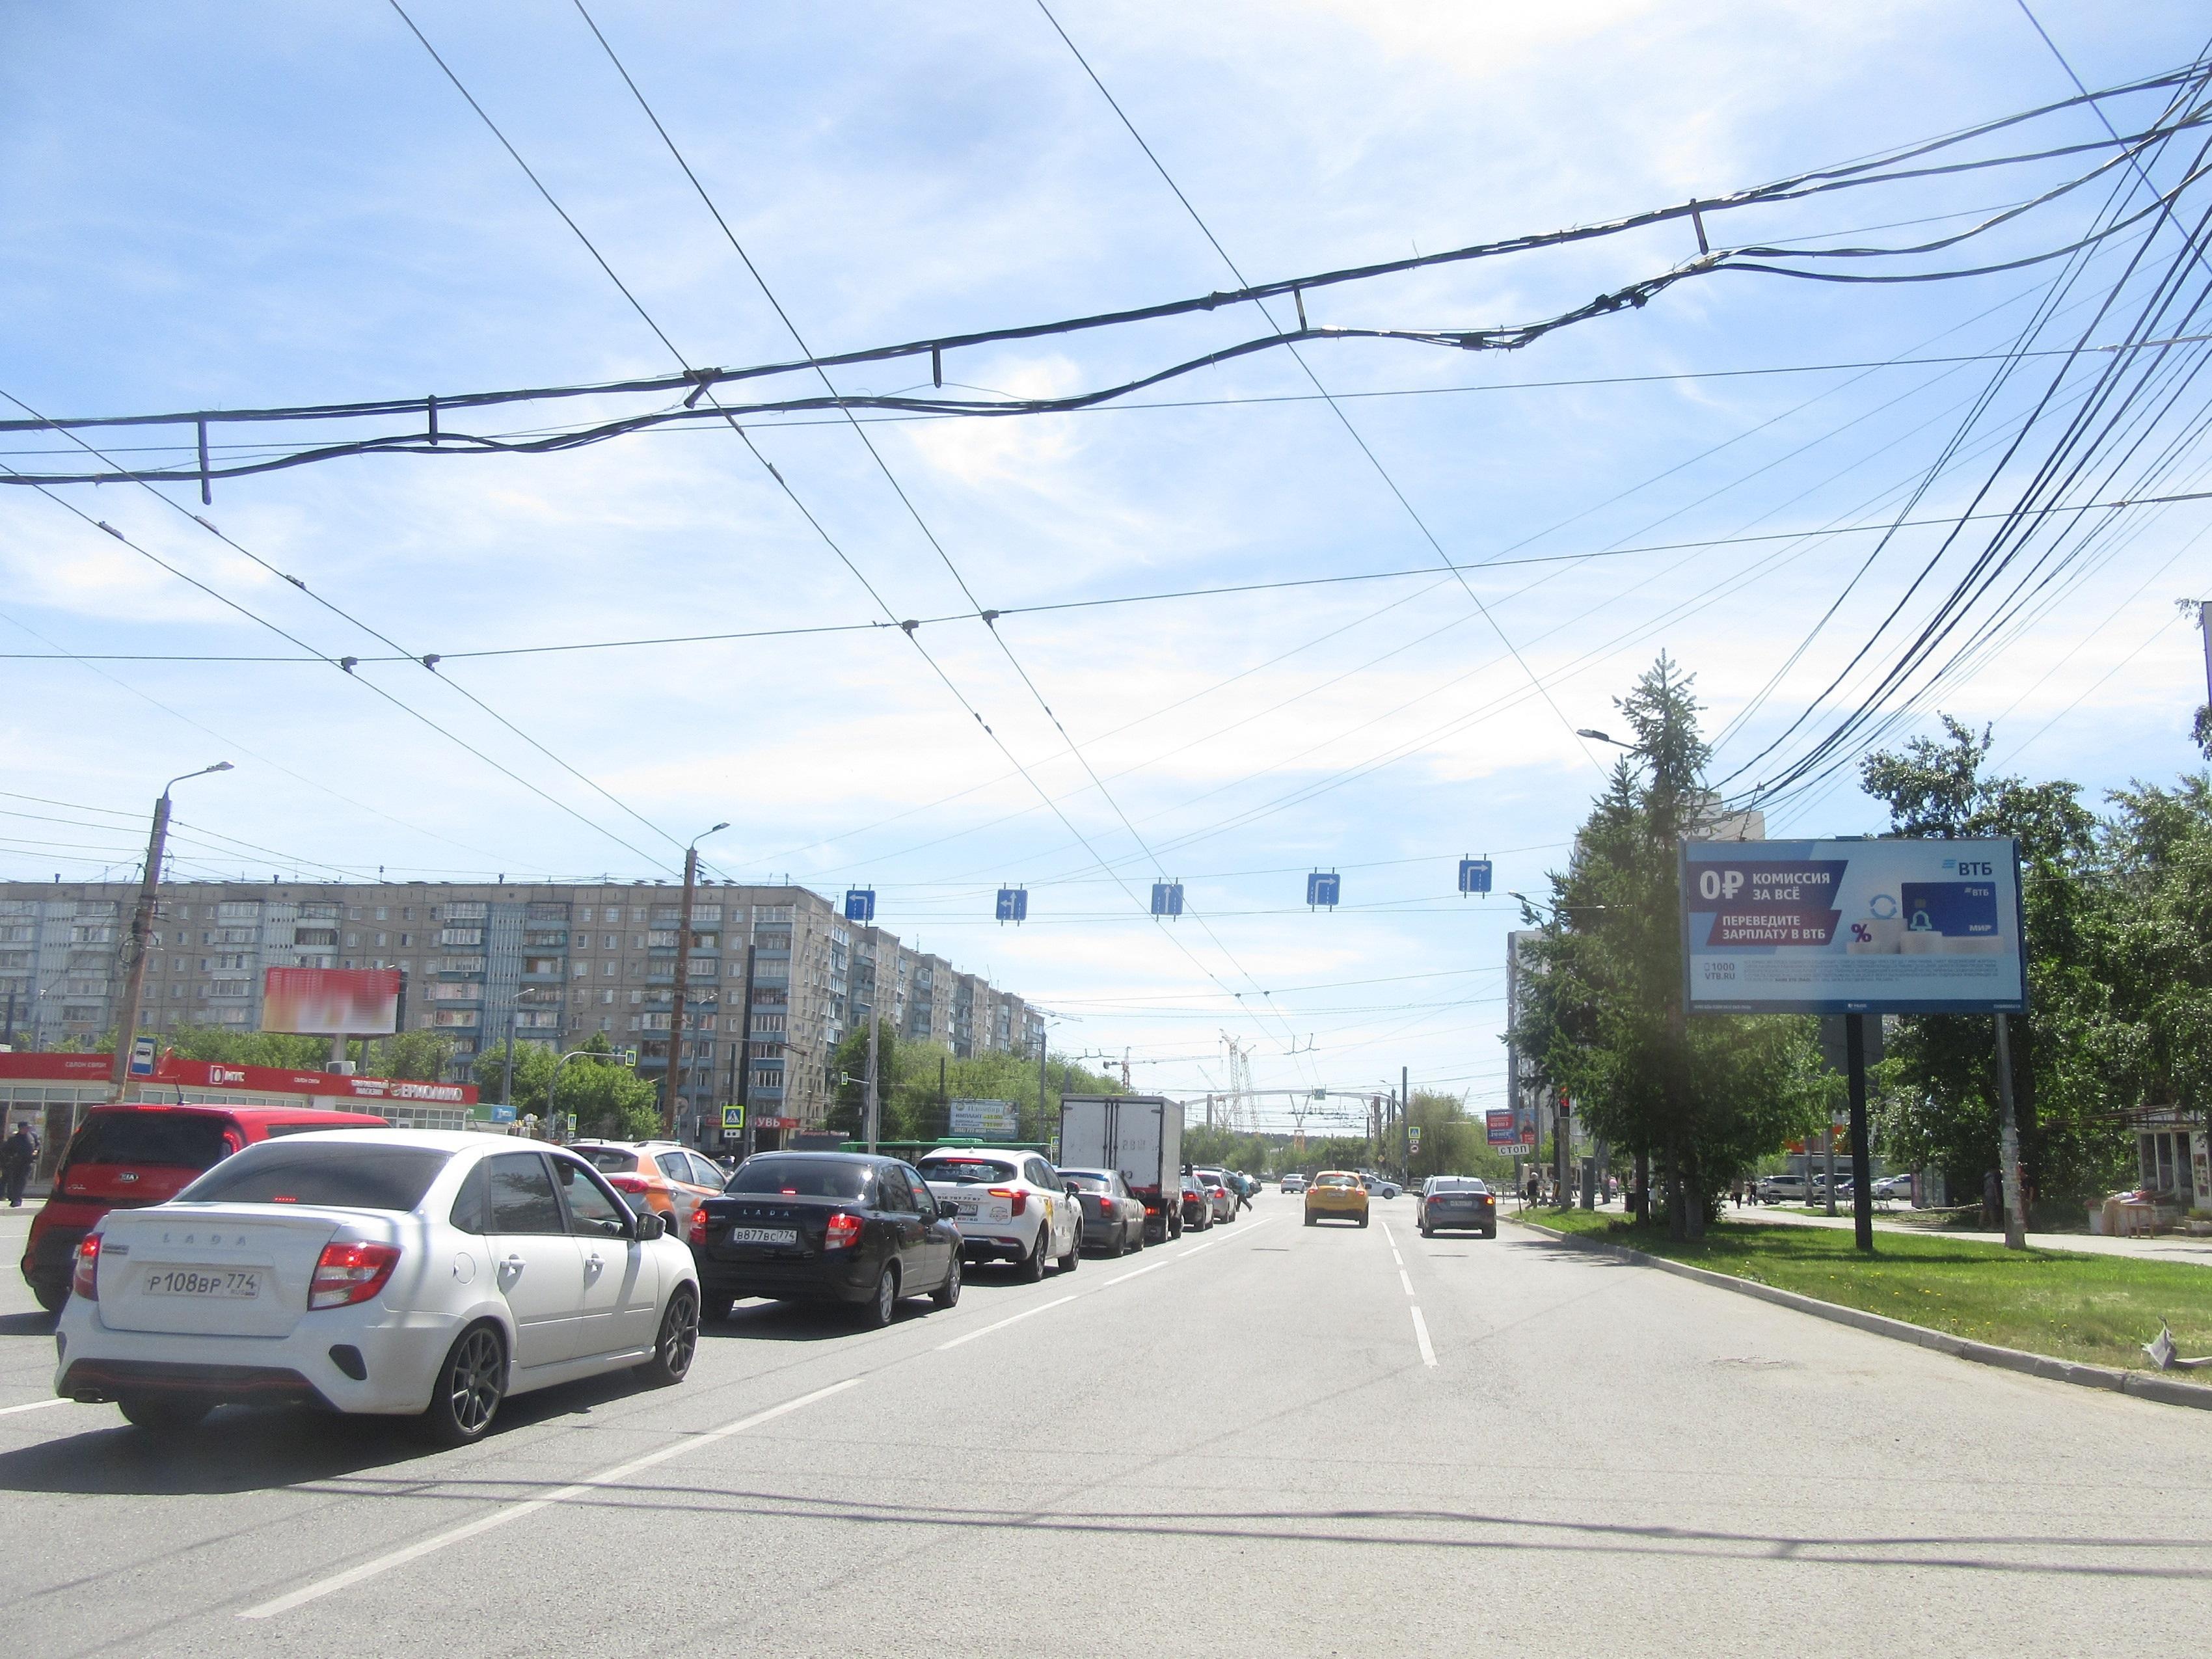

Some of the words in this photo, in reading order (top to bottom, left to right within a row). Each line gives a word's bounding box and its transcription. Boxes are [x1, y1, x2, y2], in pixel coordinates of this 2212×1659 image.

[1958, 862, 1993, 876] ВТБ
[1752, 872, 1831, 885] КОМИССИЯ
[1752, 889, 1771, 900] ЗА
[1774, 886, 1801, 900] ВСЁ
[1972, 887, 1989, 897] ВТБ
[1722, 915, 1801, 928] ПЕРЕВЕДИТЕ
[1722, 928, 1787, 940] ЗАРПЛАТУ
[1791, 928, 1800, 939] В
[1801, 928, 1826, 940] ВТБ
[1969, 924, 1993, 932] МИР
[1712, 963, 1735, 971] 1000
[224, 1071, 245, 1083] МТС
[401, 1084, 463, 1101] ЕРМОЛИНО
[1500, 1145, 1527, 1154] СТОП
[742, 1208, 790, 1217] LADA
[162, 1233, 247, 1246] LADA
[736, 1230, 777, 1241] В877ВС
[778, 1230, 794, 1240] 774
[149, 1272, 222, 1293] Р108ВР
[226, 1273, 256, 1289] 774
